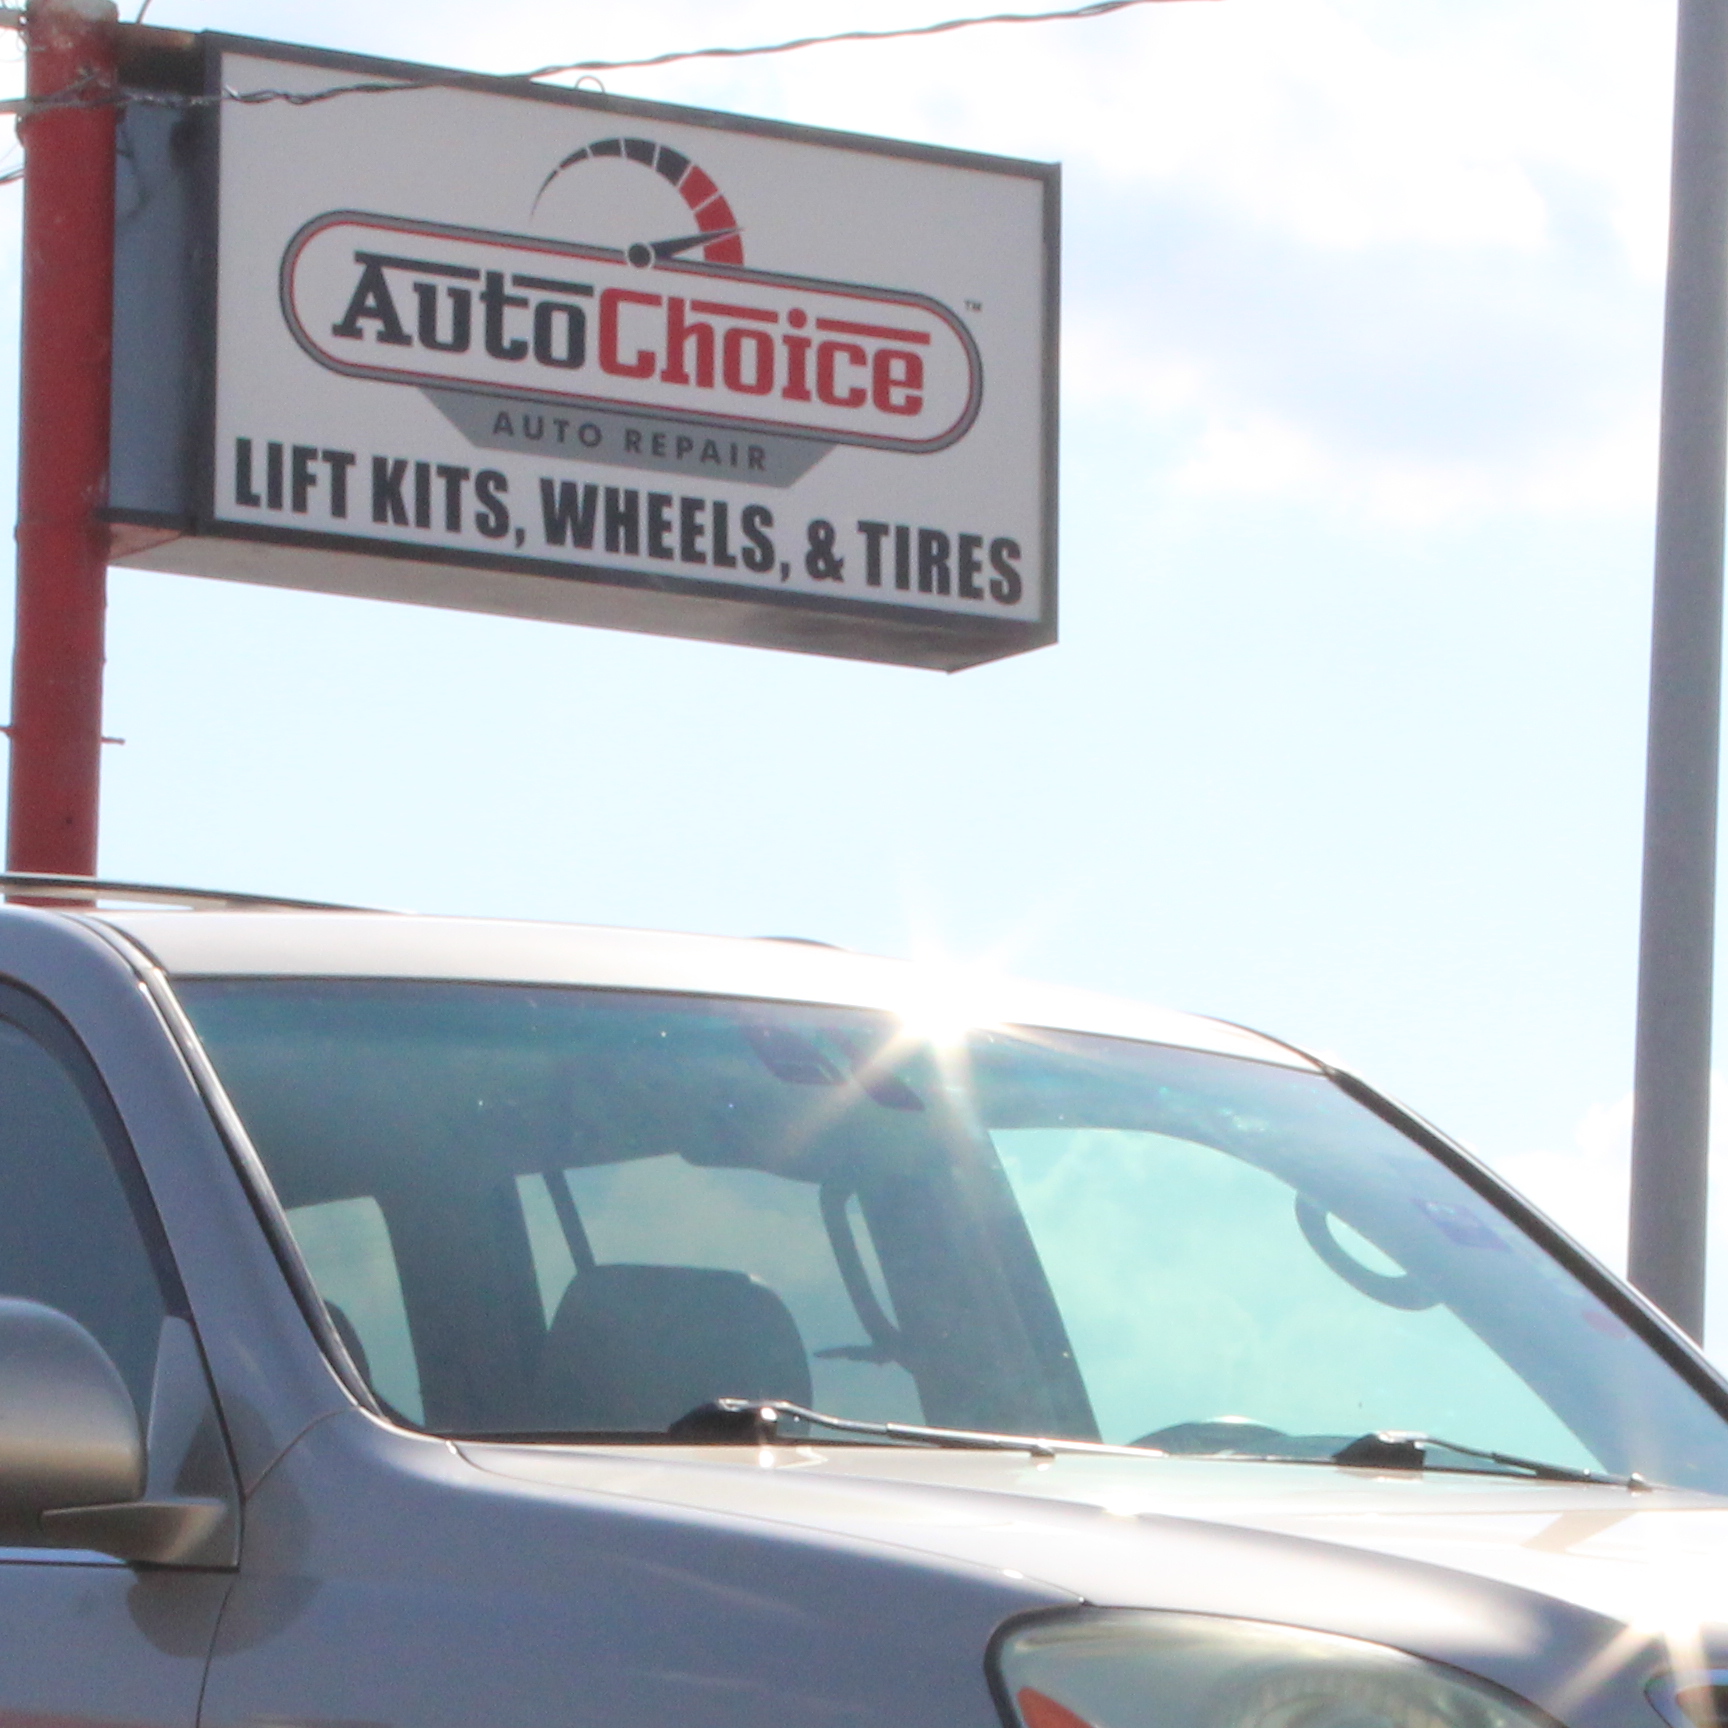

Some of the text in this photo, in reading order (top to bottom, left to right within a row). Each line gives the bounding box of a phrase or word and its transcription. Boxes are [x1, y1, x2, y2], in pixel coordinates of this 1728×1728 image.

[332, 251, 930, 416] AutoChoice
[235, 437, 1022, 605] LIFT KITS, WHEELS, & TIRES
[492, 410, 766, 471] AUTO REPAIR
